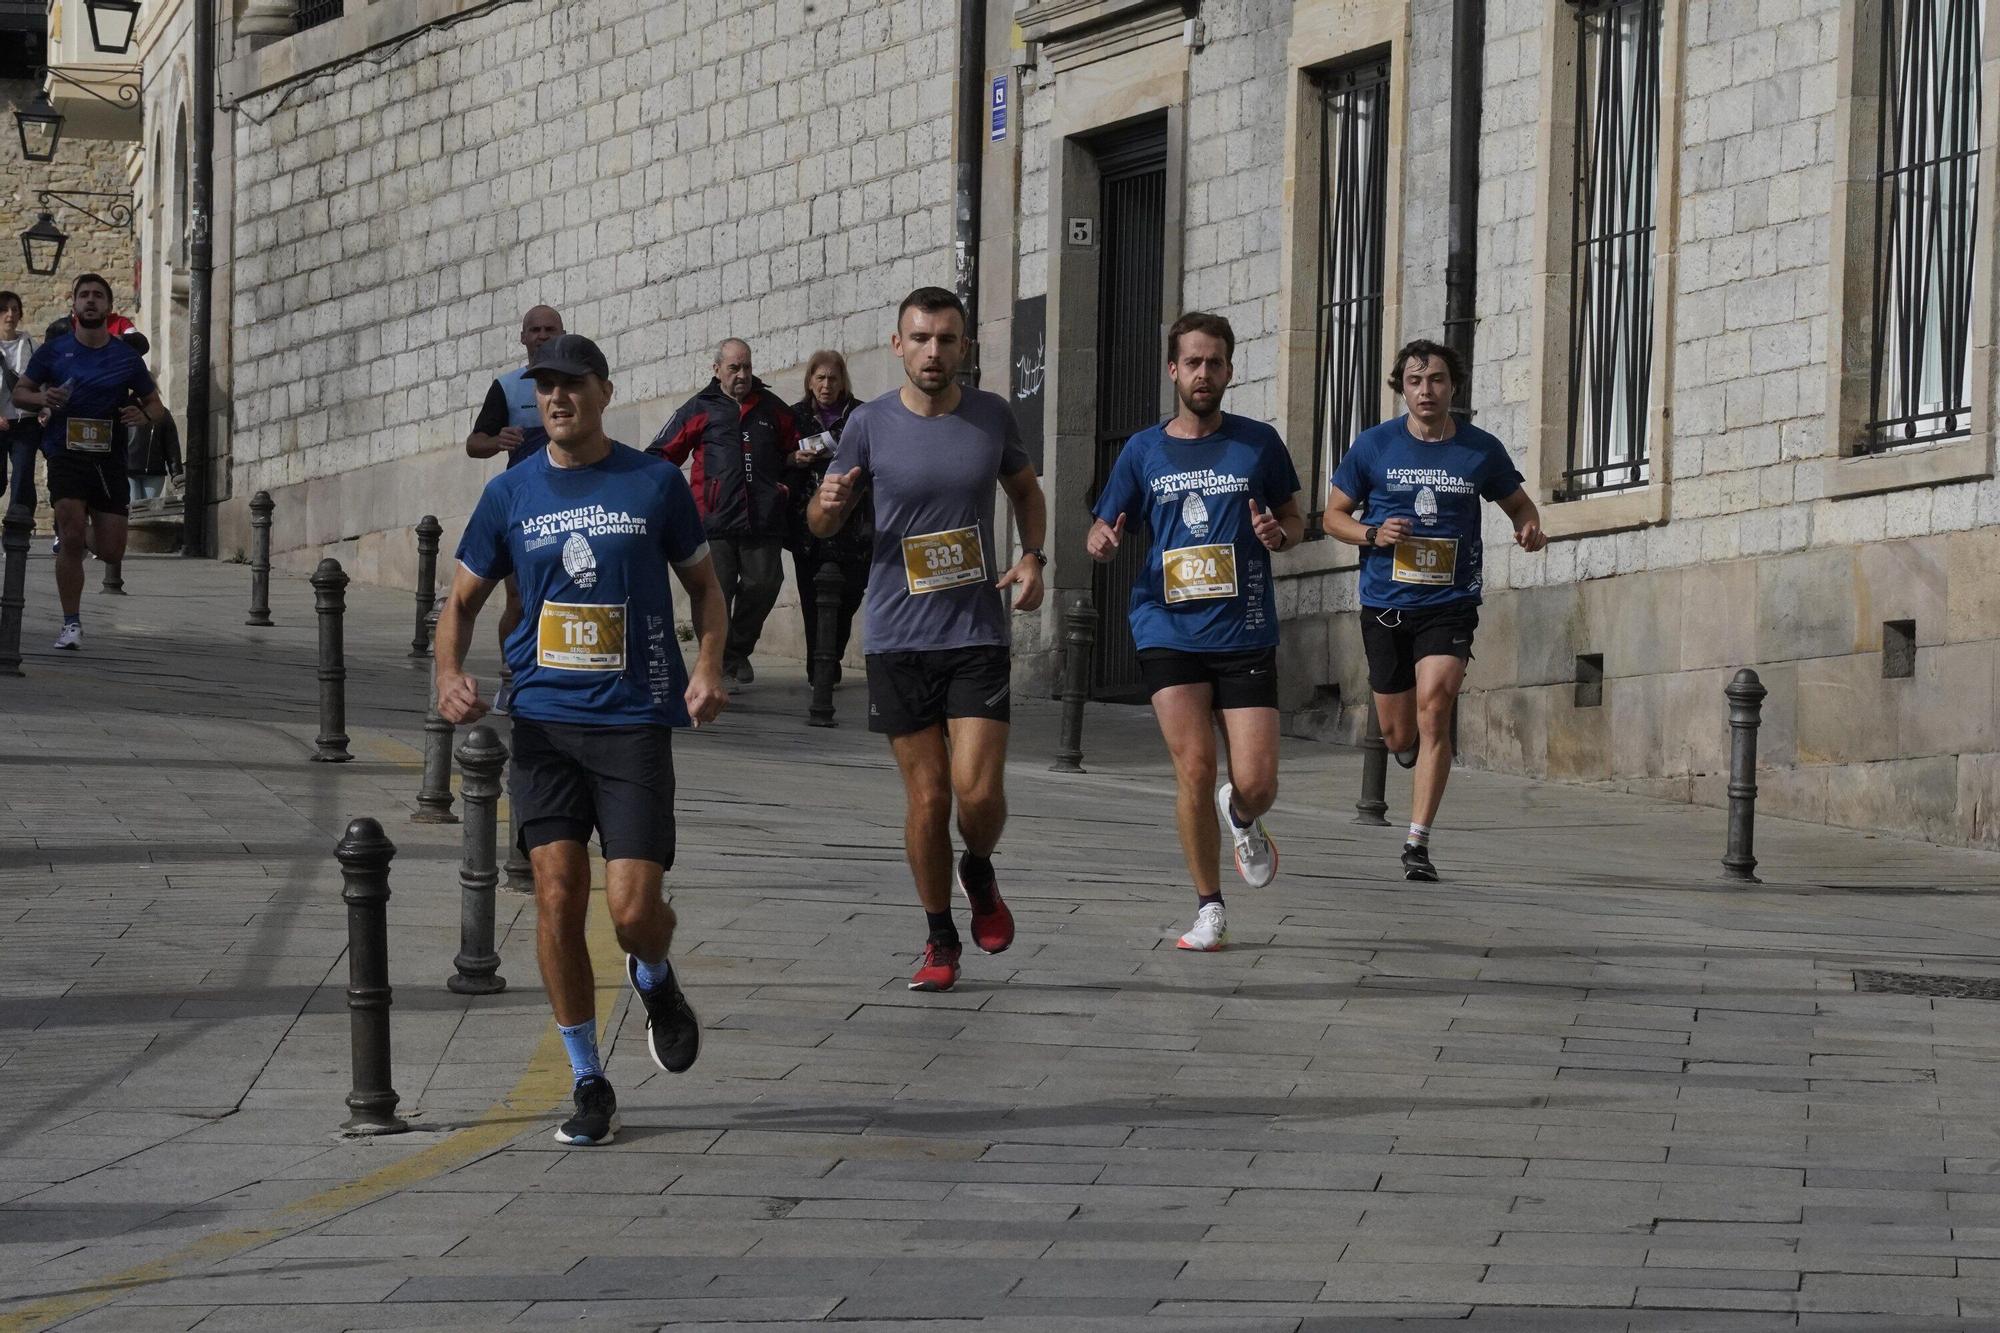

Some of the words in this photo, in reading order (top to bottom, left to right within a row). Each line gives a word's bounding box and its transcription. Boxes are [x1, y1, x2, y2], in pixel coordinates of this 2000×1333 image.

[1074, 222, 1087, 240] 5
[82, 427, 97, 440] 86
[742, 432, 752, 482] CORM
[1150, 478, 1160, 487] LA
[1160, 469, 1215, 484] CONQUISTA
[1398, 468, 1447, 476] CONQUISTA
[1400, 476, 1464, 486] ALMENDRA
[1164, 474, 1236, 494] ALMENDRA
[1203, 484, 1249, 496] KONKISTA
[1436, 486, 1474, 494] KONKISTA
[522, 518, 535, 529] LA
[536, 504, 604, 524] CONQUISTA
[540, 512, 632, 536] ALMENDRA
[588, 525, 647, 536] KONKISTA
[925, 544, 964, 569] 333
[1416, 548, 1437, 567] 56
[1181, 558, 1216, 580] 624
[562, 621, 598, 645] 113
